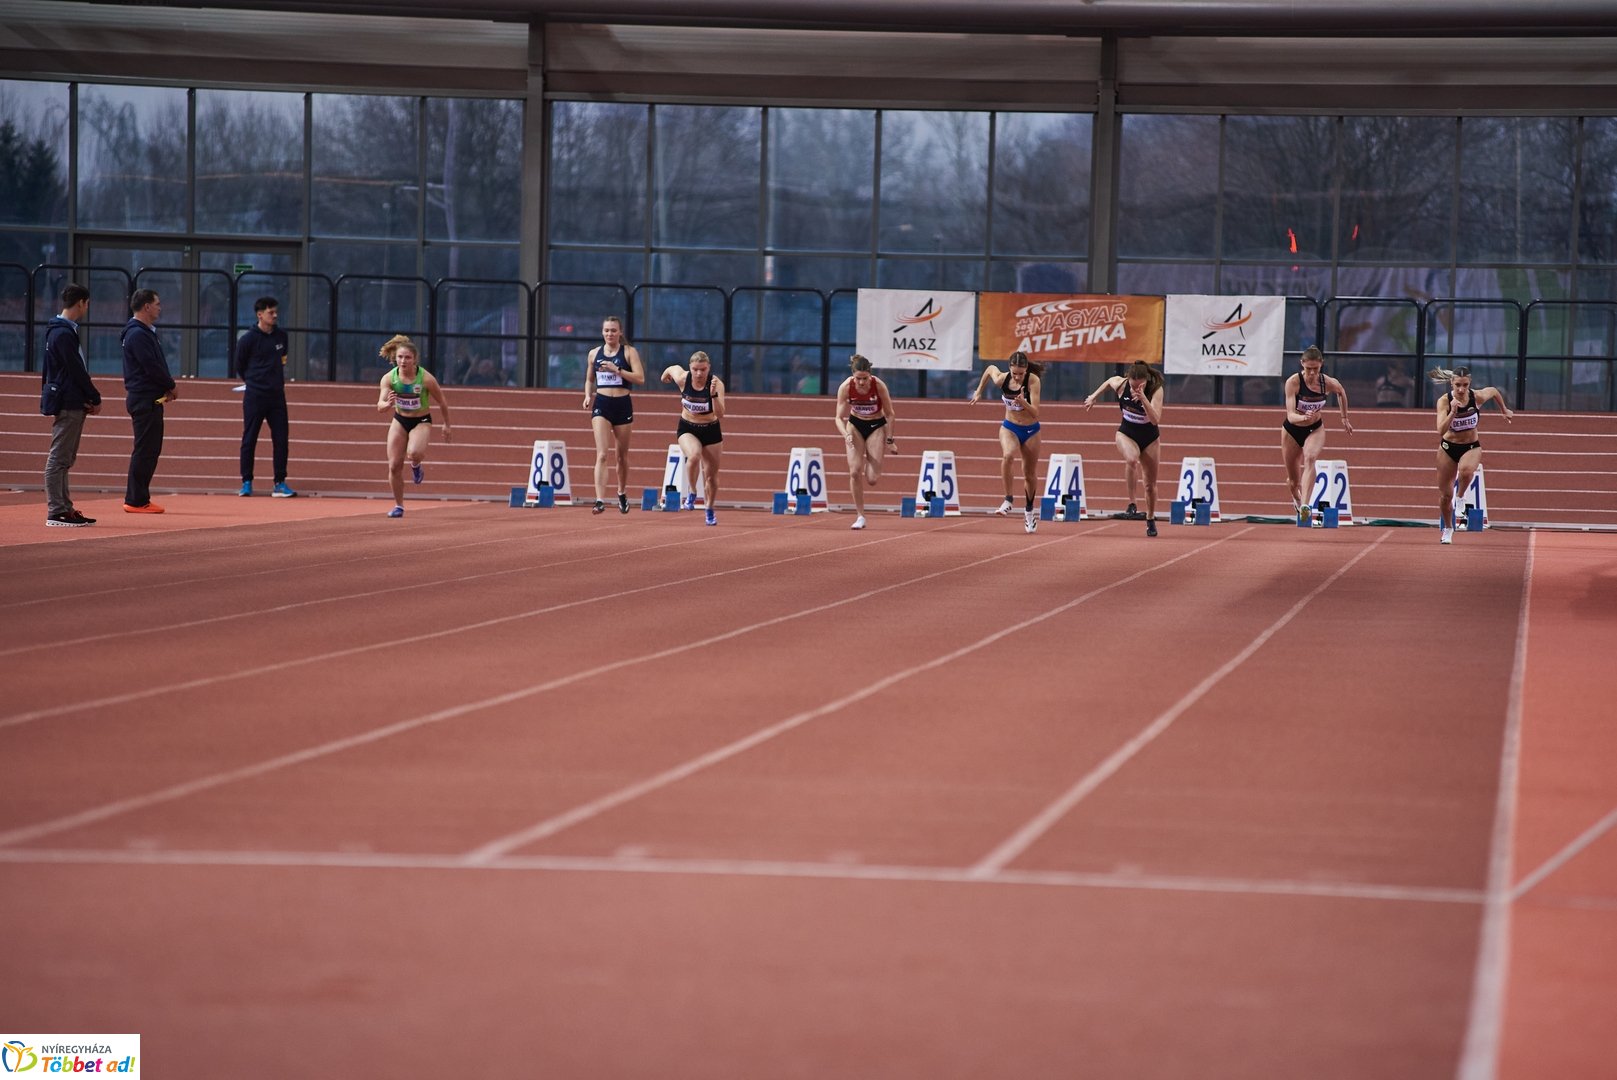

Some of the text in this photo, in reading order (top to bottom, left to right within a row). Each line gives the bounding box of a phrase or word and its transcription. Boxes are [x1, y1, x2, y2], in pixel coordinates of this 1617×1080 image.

[1015, 303, 1128, 337] #MAGYAR
[1016, 322, 1127, 353] ATLETIKA
[892, 337, 937, 351] MASZ
[1201, 343, 1247, 357] MASZ
[533, 452, 544, 490] 8
[551, 452, 565, 490] 8
[669, 456, 680, 486] 7
[790, 460, 801, 497] 6
[807, 460, 822, 498] 6
[921, 463, 935, 500] 5
[941, 463, 954, 501] 5
[1048, 465, 1062, 503] 4
[1068, 465, 1082, 501] 4
[1181, 469, 1195, 507] 3
[1201, 469, 1215, 507] 3
[1312, 471, 1328, 509] 2
[1334, 472, 1348, 511] 2
[1470, 475, 1480, 510] 1
